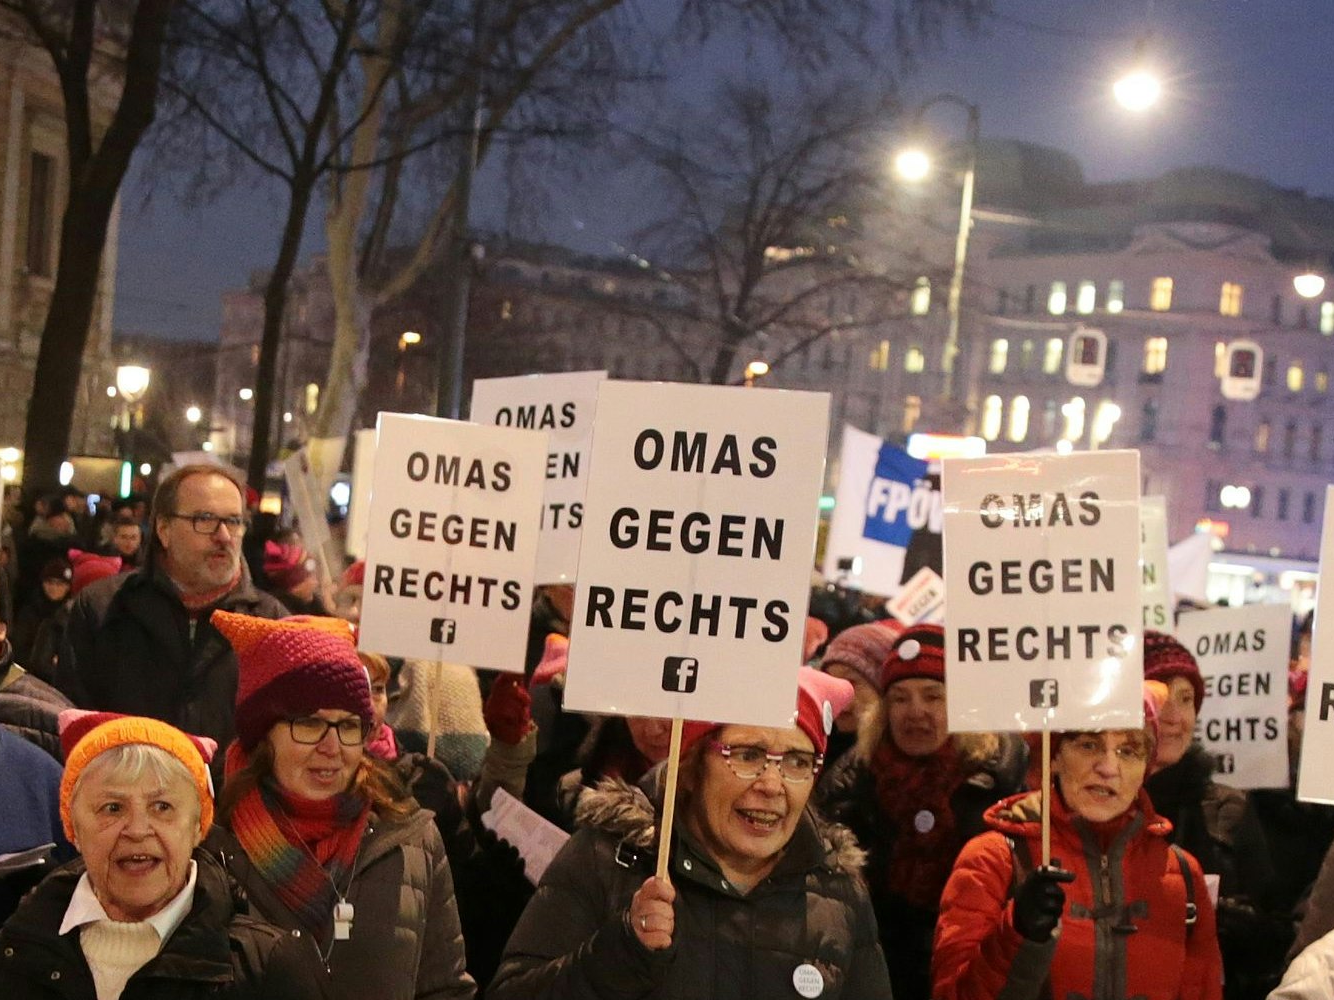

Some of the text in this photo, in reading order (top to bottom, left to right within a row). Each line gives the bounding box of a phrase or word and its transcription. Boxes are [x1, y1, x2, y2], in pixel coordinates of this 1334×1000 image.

[495, 402, 576, 430] OMAS
[407, 451, 511, 492] OMAS
[634, 428, 777, 478] OMAS
[390, 508, 517, 552] GEGEN
[980, 491, 1101, 528] OMAS
[609, 507, 784, 560] GEGEN
[373, 564, 521, 610] RECHTS
[968, 558, 1115, 595] GEGEN
[585, 585, 790, 642] RECHTS
[958, 624, 1128, 662] RECHTS
[1196, 629, 1266, 656] OMAS
